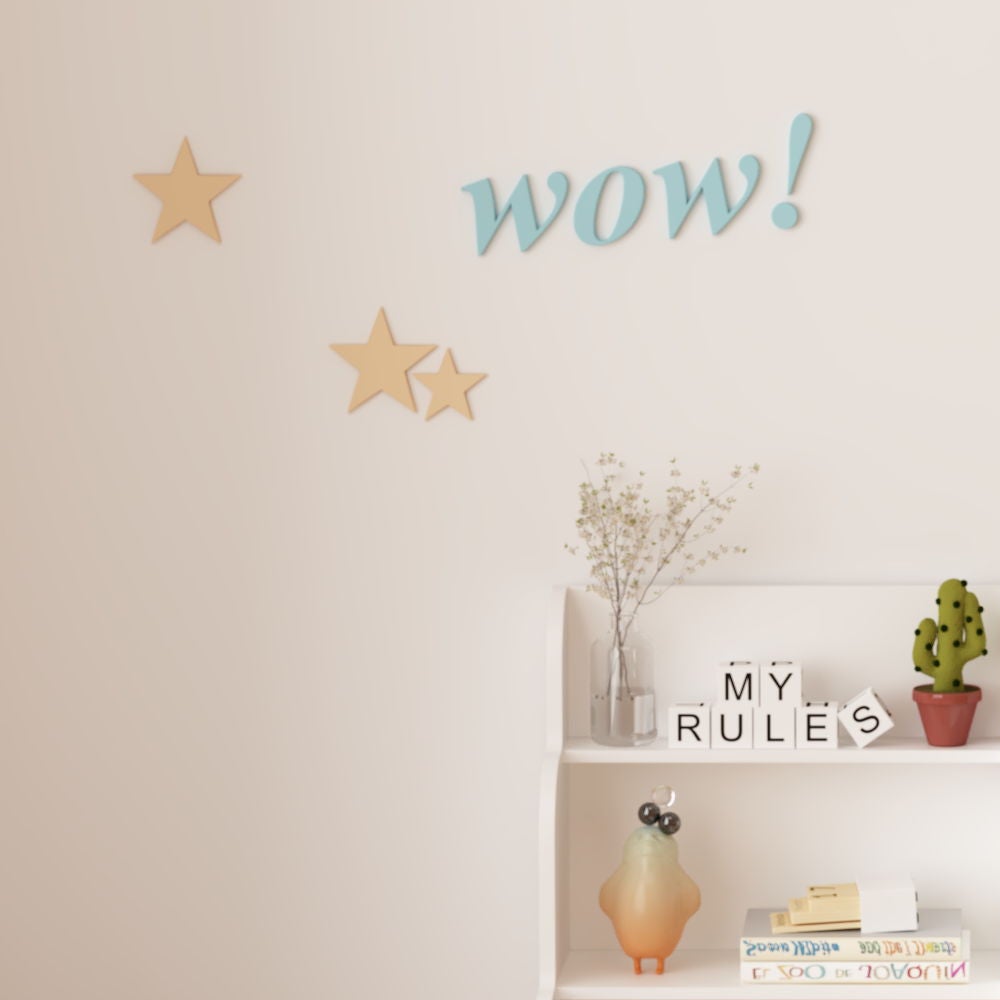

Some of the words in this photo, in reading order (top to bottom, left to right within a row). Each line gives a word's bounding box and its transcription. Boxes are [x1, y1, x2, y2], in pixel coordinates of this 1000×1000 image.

[461, 112, 814, 256] wow!
[725, 672, 793, 701] MY
[677, 705, 880, 742] RULES
